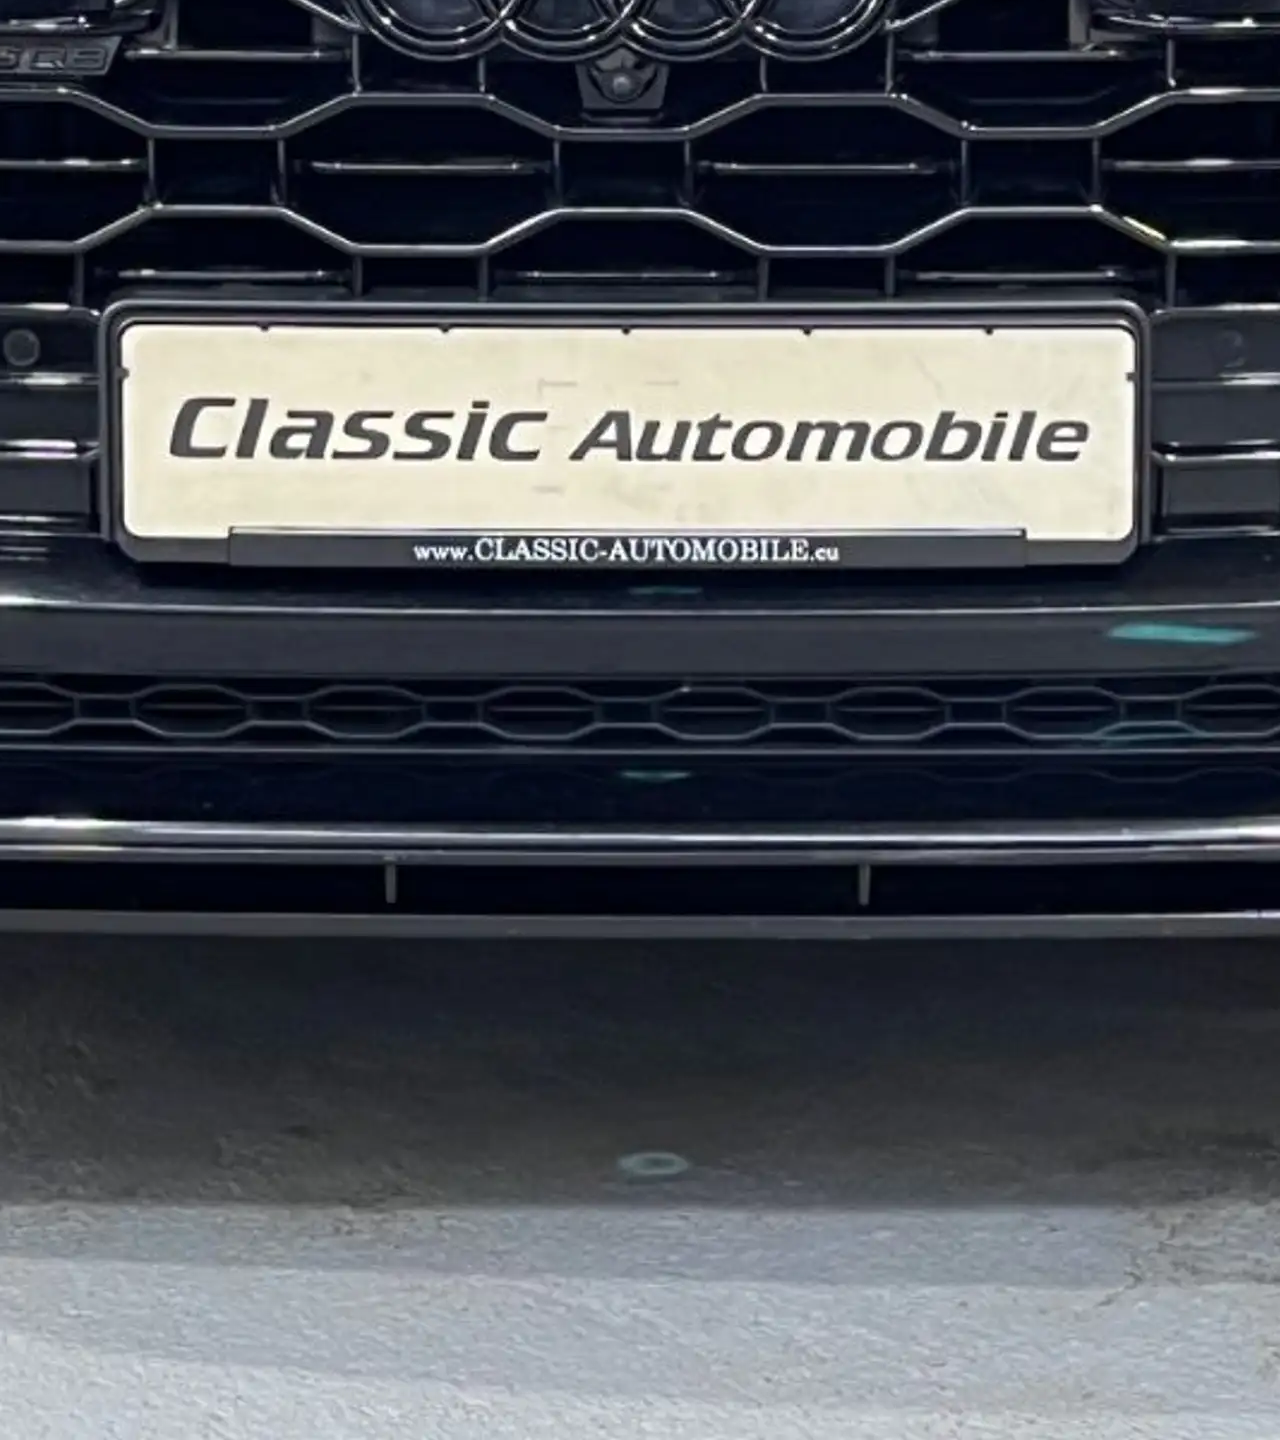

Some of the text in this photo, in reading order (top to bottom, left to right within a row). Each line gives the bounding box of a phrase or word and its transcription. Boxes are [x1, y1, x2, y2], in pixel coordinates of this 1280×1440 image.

[169, 397, 1089, 463] Classic Automobile
[412, 537, 840, 563] www.CLASSIC-AUTOMOBILE.eu
